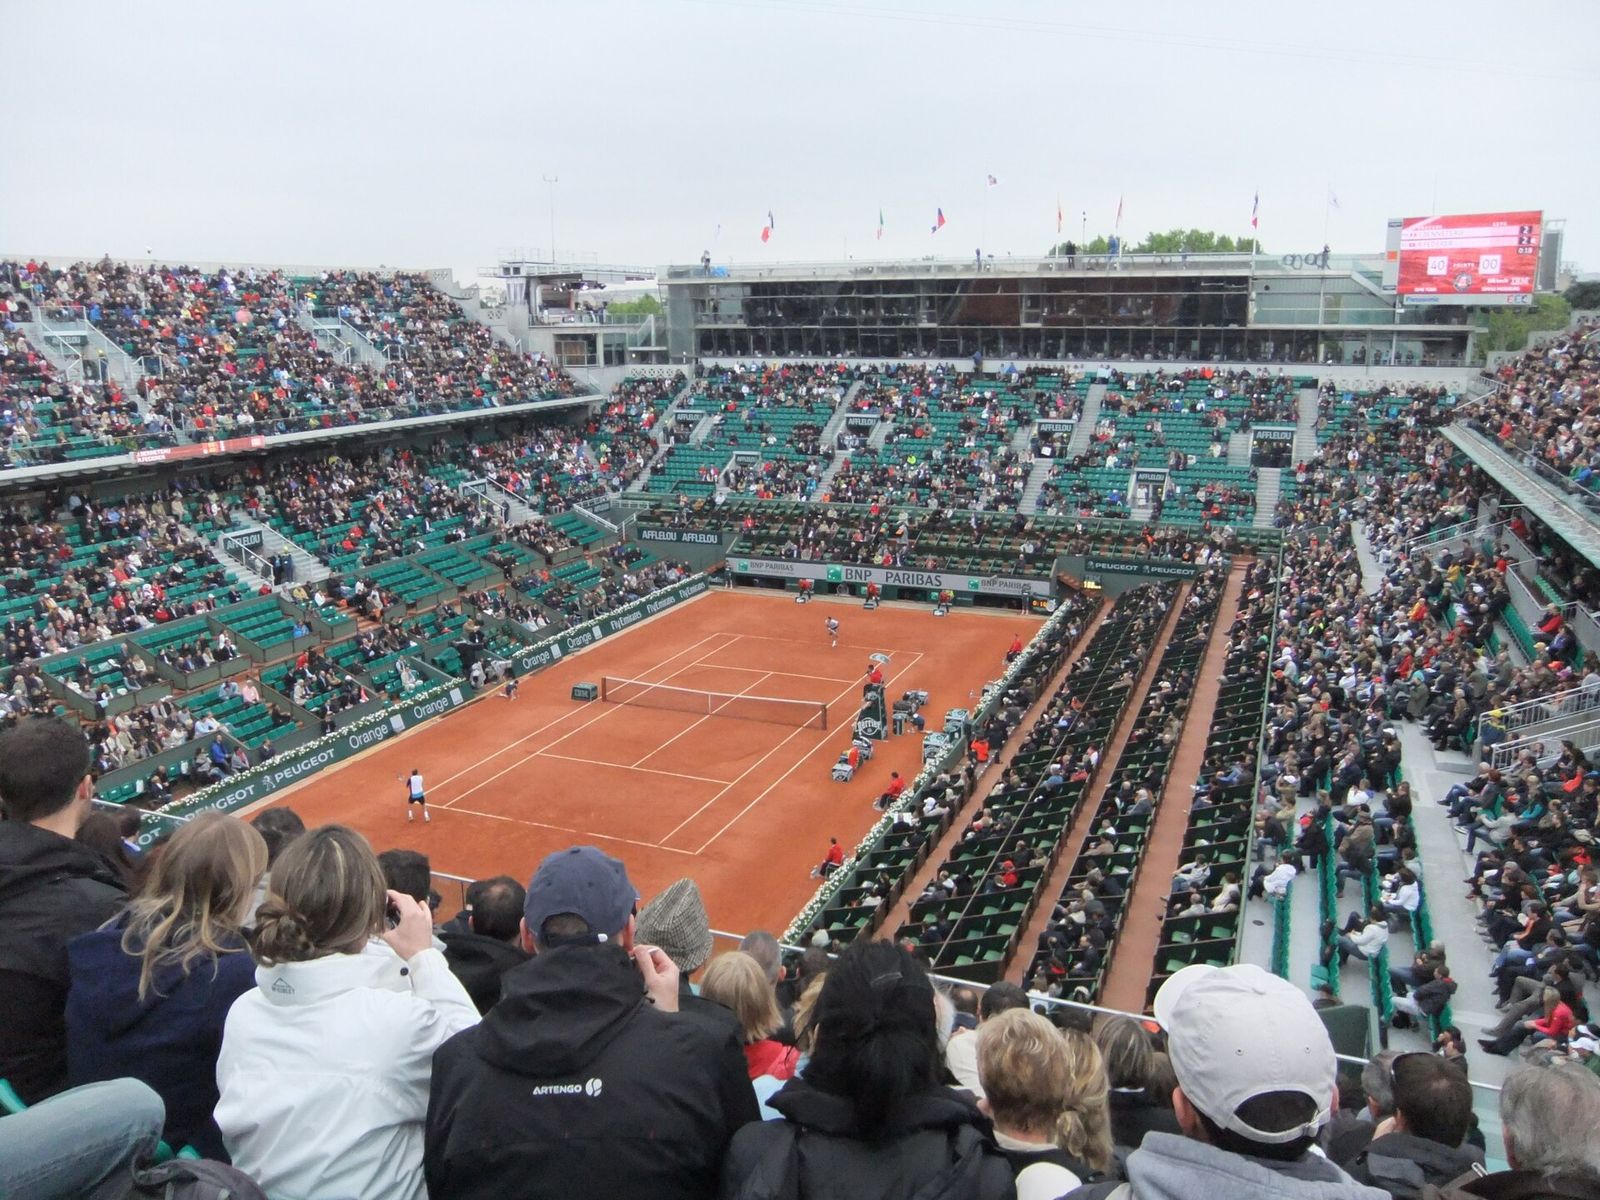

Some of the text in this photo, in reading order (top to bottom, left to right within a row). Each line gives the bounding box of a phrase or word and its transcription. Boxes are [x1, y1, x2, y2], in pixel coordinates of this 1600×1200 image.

[1431, 260, 1445, 270] 40
[1482, 259, 1498, 270] 00
[1040, 423, 1072, 432] AFFLELOU
[1256, 430, 1292, 440] AFFLELOU
[642, 530, 718, 544] AFFLELOU AFFLELOU
[750, 561, 794, 571] BNP PARIBAS
[1095, 563, 1196, 576] PEUGEOT PEUGEOT
[845, 568, 942, 587] BNP PARIBAS
[981, 579, 997, 587] BNP
[523, 650, 550, 670] Orange
[567, 631, 592, 649] Orange
[275, 749, 335, 784] PEUGEOT
[349, 723, 388, 749] Orange
[413, 696, 449, 719] Orange
[533, 1084, 582, 1095] ARTENGO
